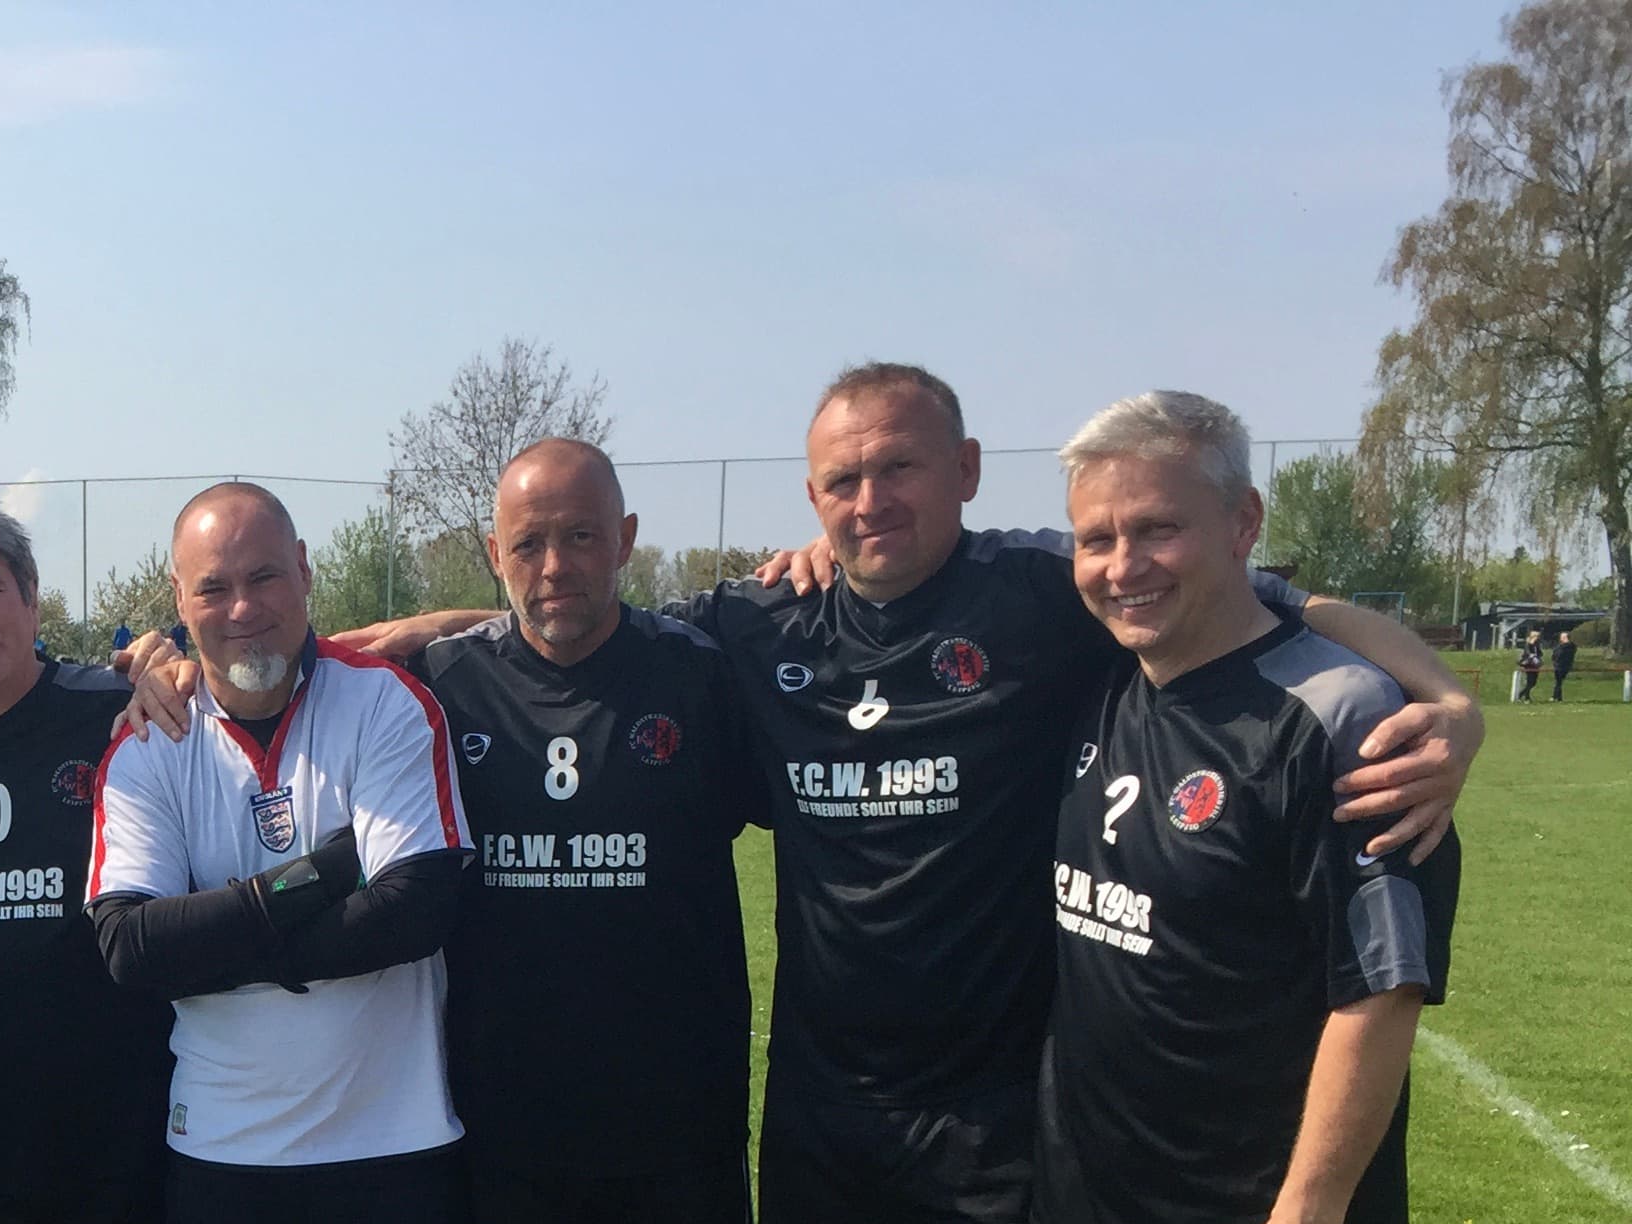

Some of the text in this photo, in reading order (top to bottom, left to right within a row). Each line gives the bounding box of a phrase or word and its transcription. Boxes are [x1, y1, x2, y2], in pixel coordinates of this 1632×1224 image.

[848, 680, 889, 730] 6
[544, 737, 579, 800] 8
[786, 756, 959, 798] F.C.W. 1993
[809, 801, 860, 817] FREUNDE
[860, 801, 898, 817] SOLLT
[899, 800, 924, 816] IHR
[926, 797, 959, 815] SEIN
[1102, 775, 1140, 844] 2
[483, 833, 647, 868] F.C.W. 1993
[484, 872, 646, 888] ELF FREUNDE SOLLT IHR SEIN
[13, 904, 35, 919] IHR
[36, 903, 64, 918] SEIN
